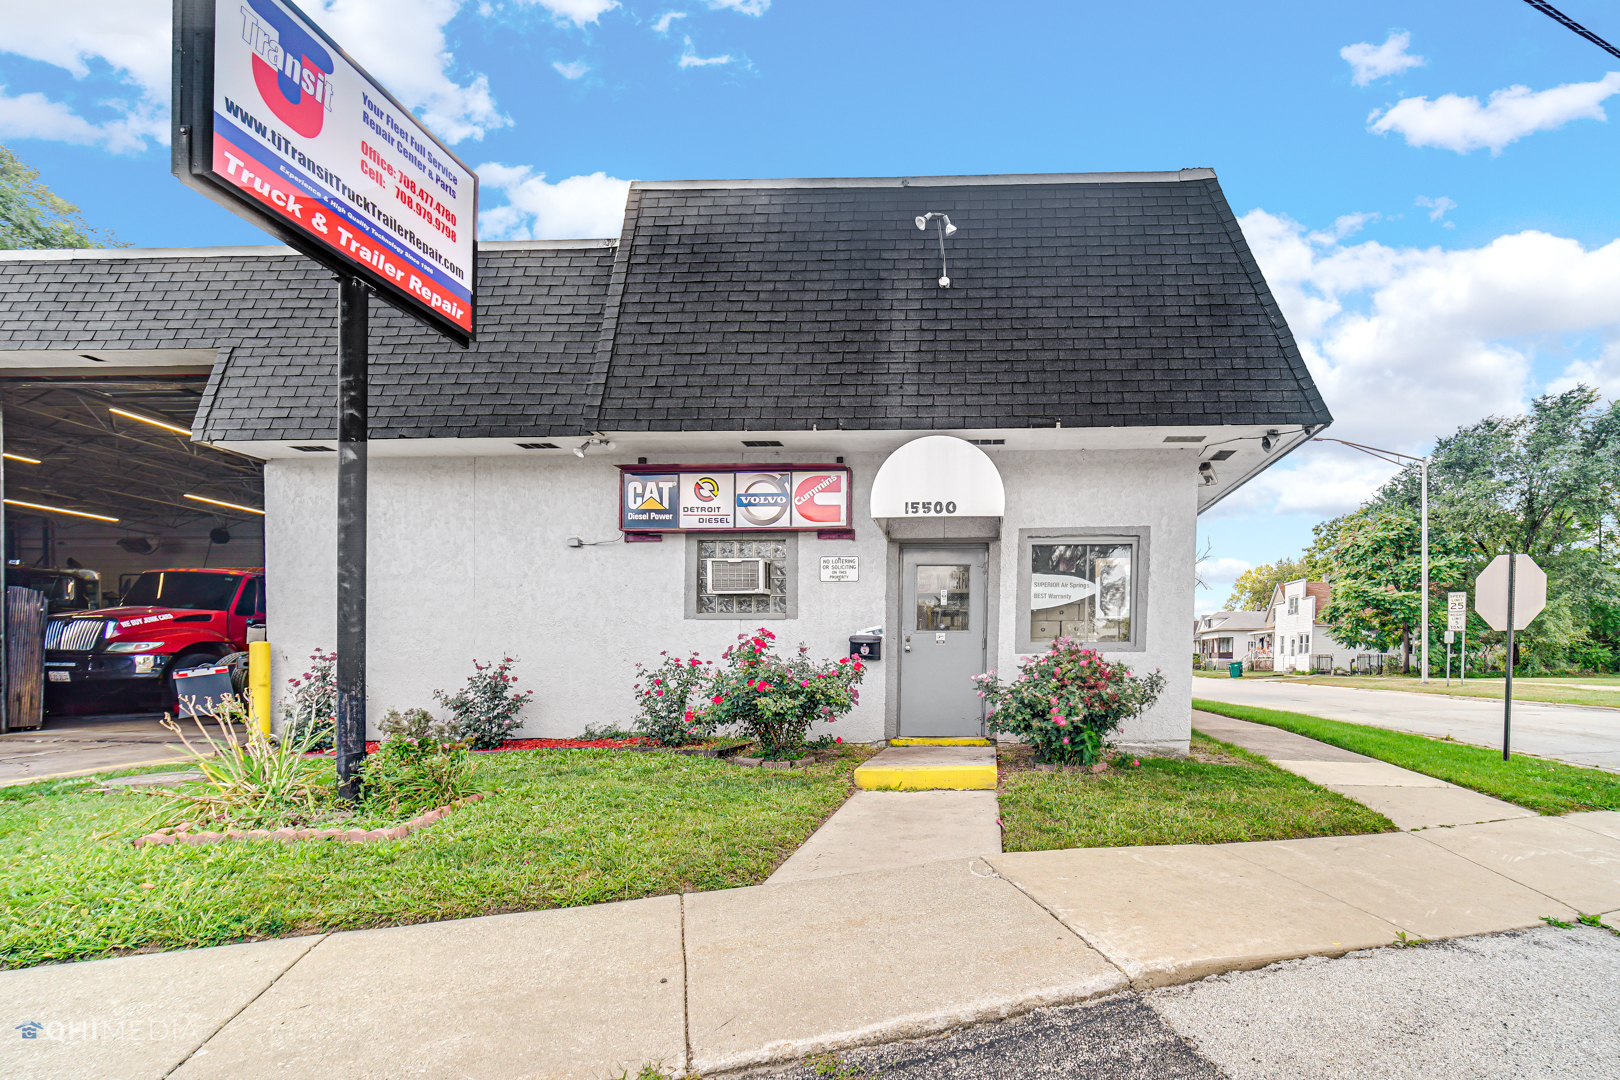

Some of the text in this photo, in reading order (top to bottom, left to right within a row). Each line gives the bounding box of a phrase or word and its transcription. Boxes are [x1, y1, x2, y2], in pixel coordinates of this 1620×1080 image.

[240, 5, 334, 113] Transit
[362, 91, 458, 186] Your Fleet Full Service
[362, 110, 457, 200] Repair Center & Parts
[224, 95, 465, 281] www.tjTransitTruckTrailerRepair.com
[360, 159, 457, 243] Cell: 708.979.9798
[361, 140, 457, 227] Office: 708.477.4780
[223, 150, 465, 320] Truck & Trailer Repair
[279, 164, 322, 199] Experience
[322, 195, 329, 203] &
[330, 199, 346, 215] High
[347, 211, 371, 231] Quality
[371, 227, 404, 255] Technology
[404, 251, 421, 266] Since
[627, 481, 674, 510] CAT
[627, 512, 673, 520] Diesel Power
[739, 495, 787, 504] VOLVO
[794, 474, 838, 506] Cummins
[904, 501, 957, 515] 15500
[1069, 582, 1090, 590] Springs
[1450, 602, 1464, 610] 25
[120, 613, 174, 628] WE BUY JUNK CARS
